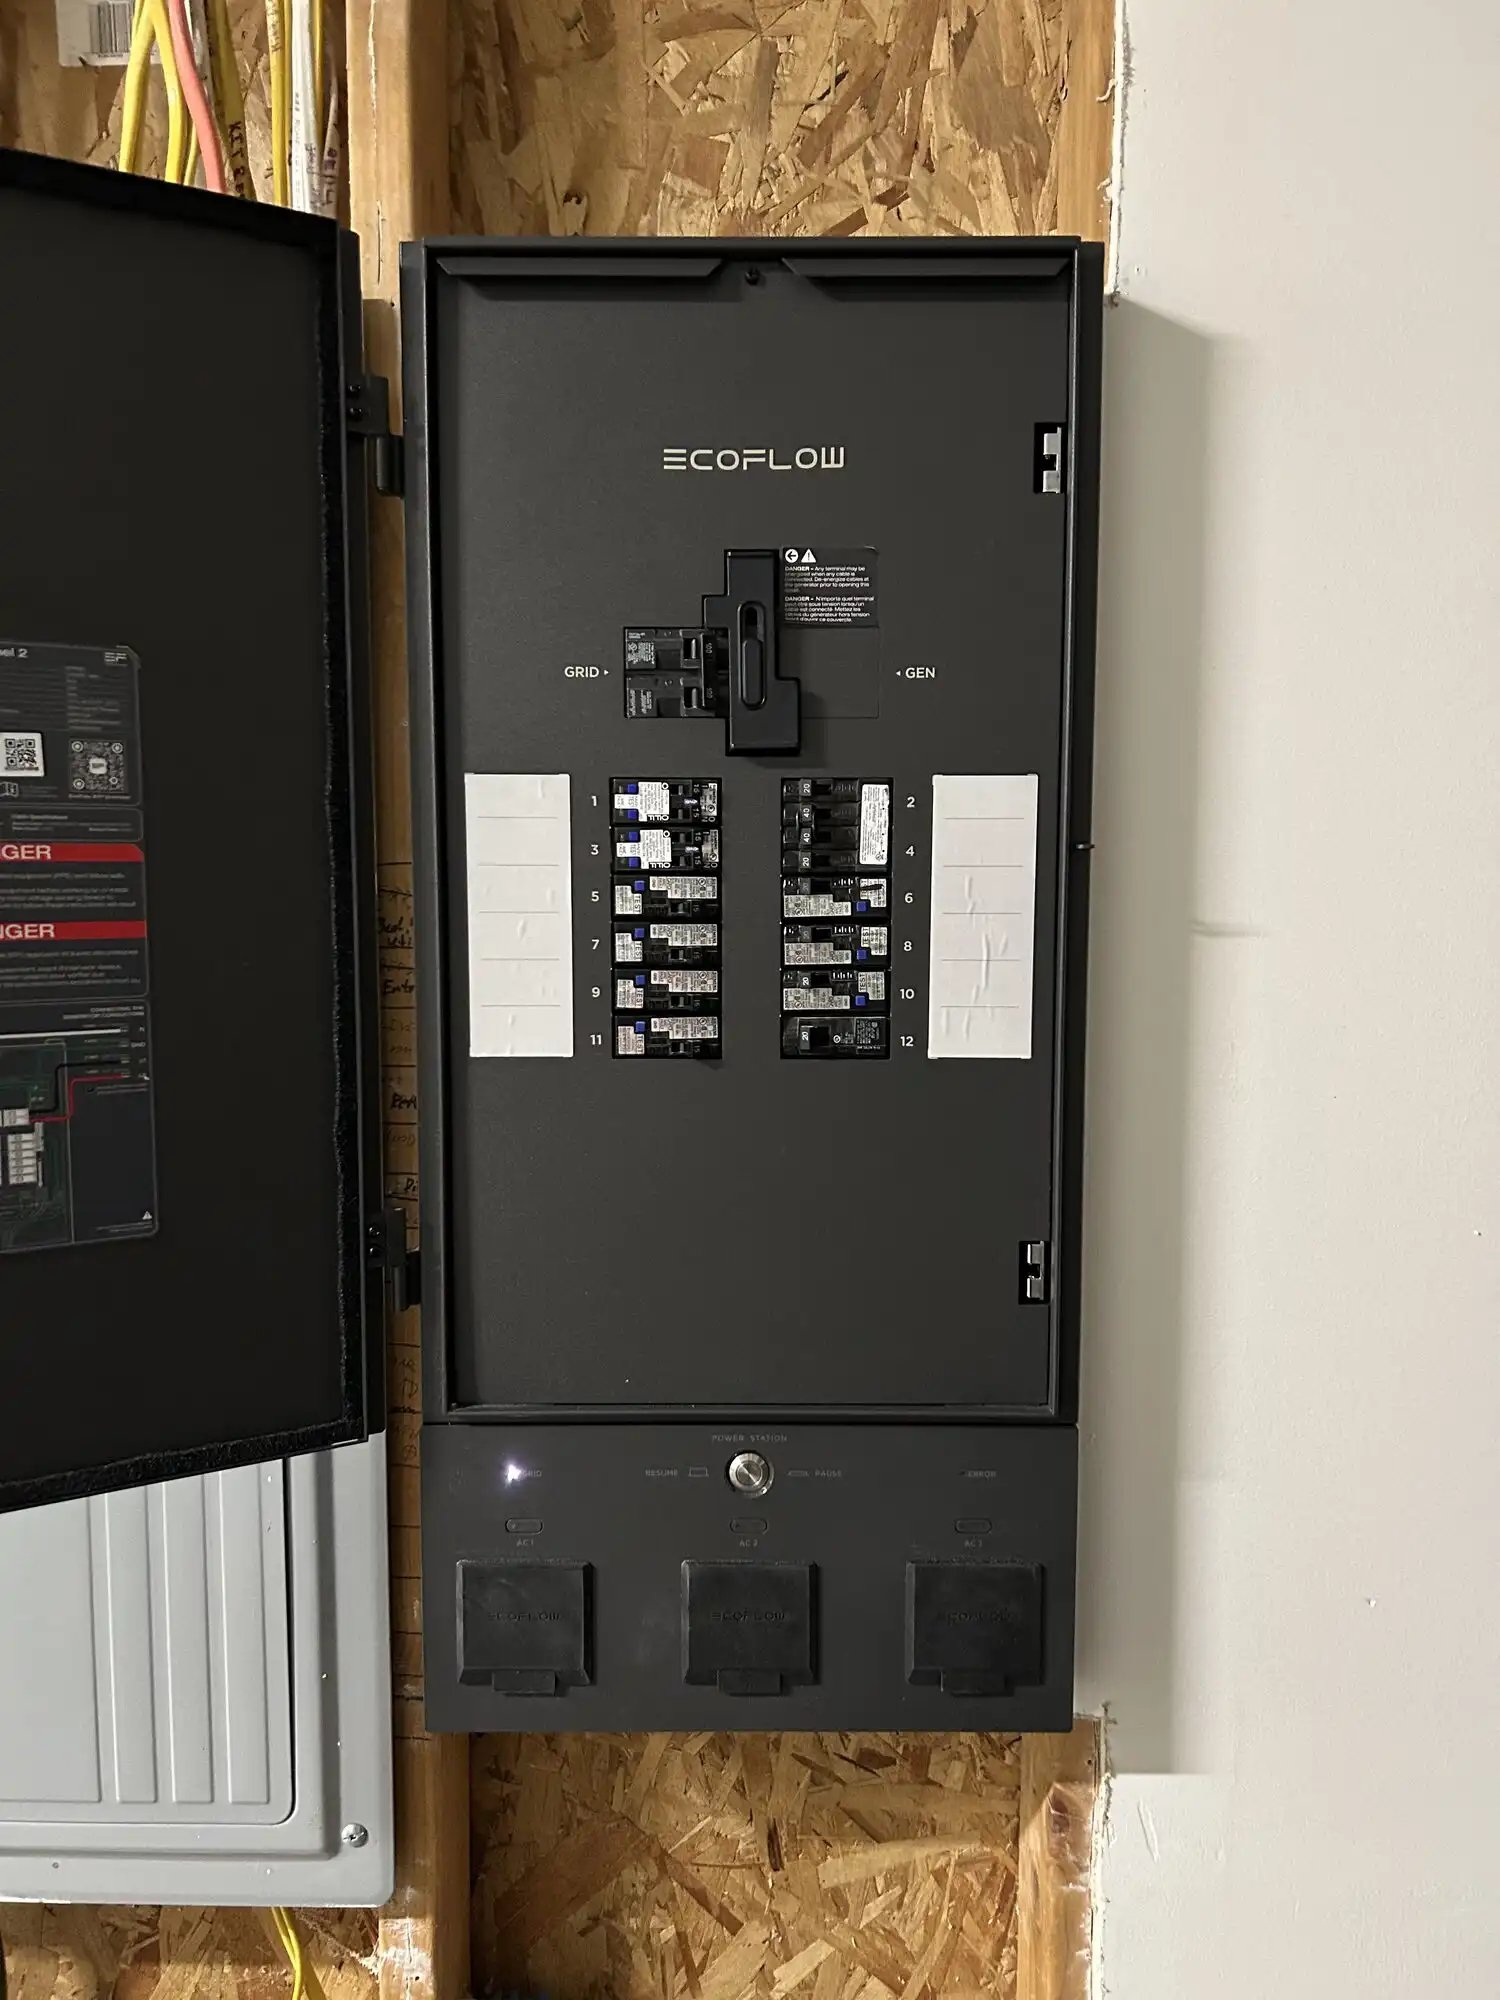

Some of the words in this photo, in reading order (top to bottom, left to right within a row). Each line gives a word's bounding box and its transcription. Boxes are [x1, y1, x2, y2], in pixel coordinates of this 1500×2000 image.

[663, 447, 845, 471] ECOFLOW
[18, 648, 29, 658] 2
[564, 666, 600, 678] GRID
[905, 666, 936, 679] GEN
[803, 783, 810, 794] 20
[591, 796, 597, 806] 1
[906, 797, 915, 808] 2
[803, 807, 810, 818] 40
[803, 832, 810, 843] 40
[591, 845, 599, 855] 3
[906, 846, 915, 857] 4
[802, 857, 809, 867] 20
[591, 891, 600, 902] 5
[904, 893, 914, 904] 6
[0, 923, 56, 939] GER
[591, 939, 600, 950] 7
[903, 940, 913, 951] 8
[802, 977, 809, 986] 20
[591, 987, 600, 998] 9
[900, 989, 915, 1000] 10
[590, 1034, 602, 1046] 11
[802, 1031, 809, 1041] 20
[900, 1036, 914, 1047] 12
[711, 1435, 745, 1443] POWER
[749, 1434, 788, 1443] STATION
[645, 1469, 679, 1477] RESUME
[814, 1469, 843, 1477] PAUSE
[966, 1469, 997, 1478] ERROR
